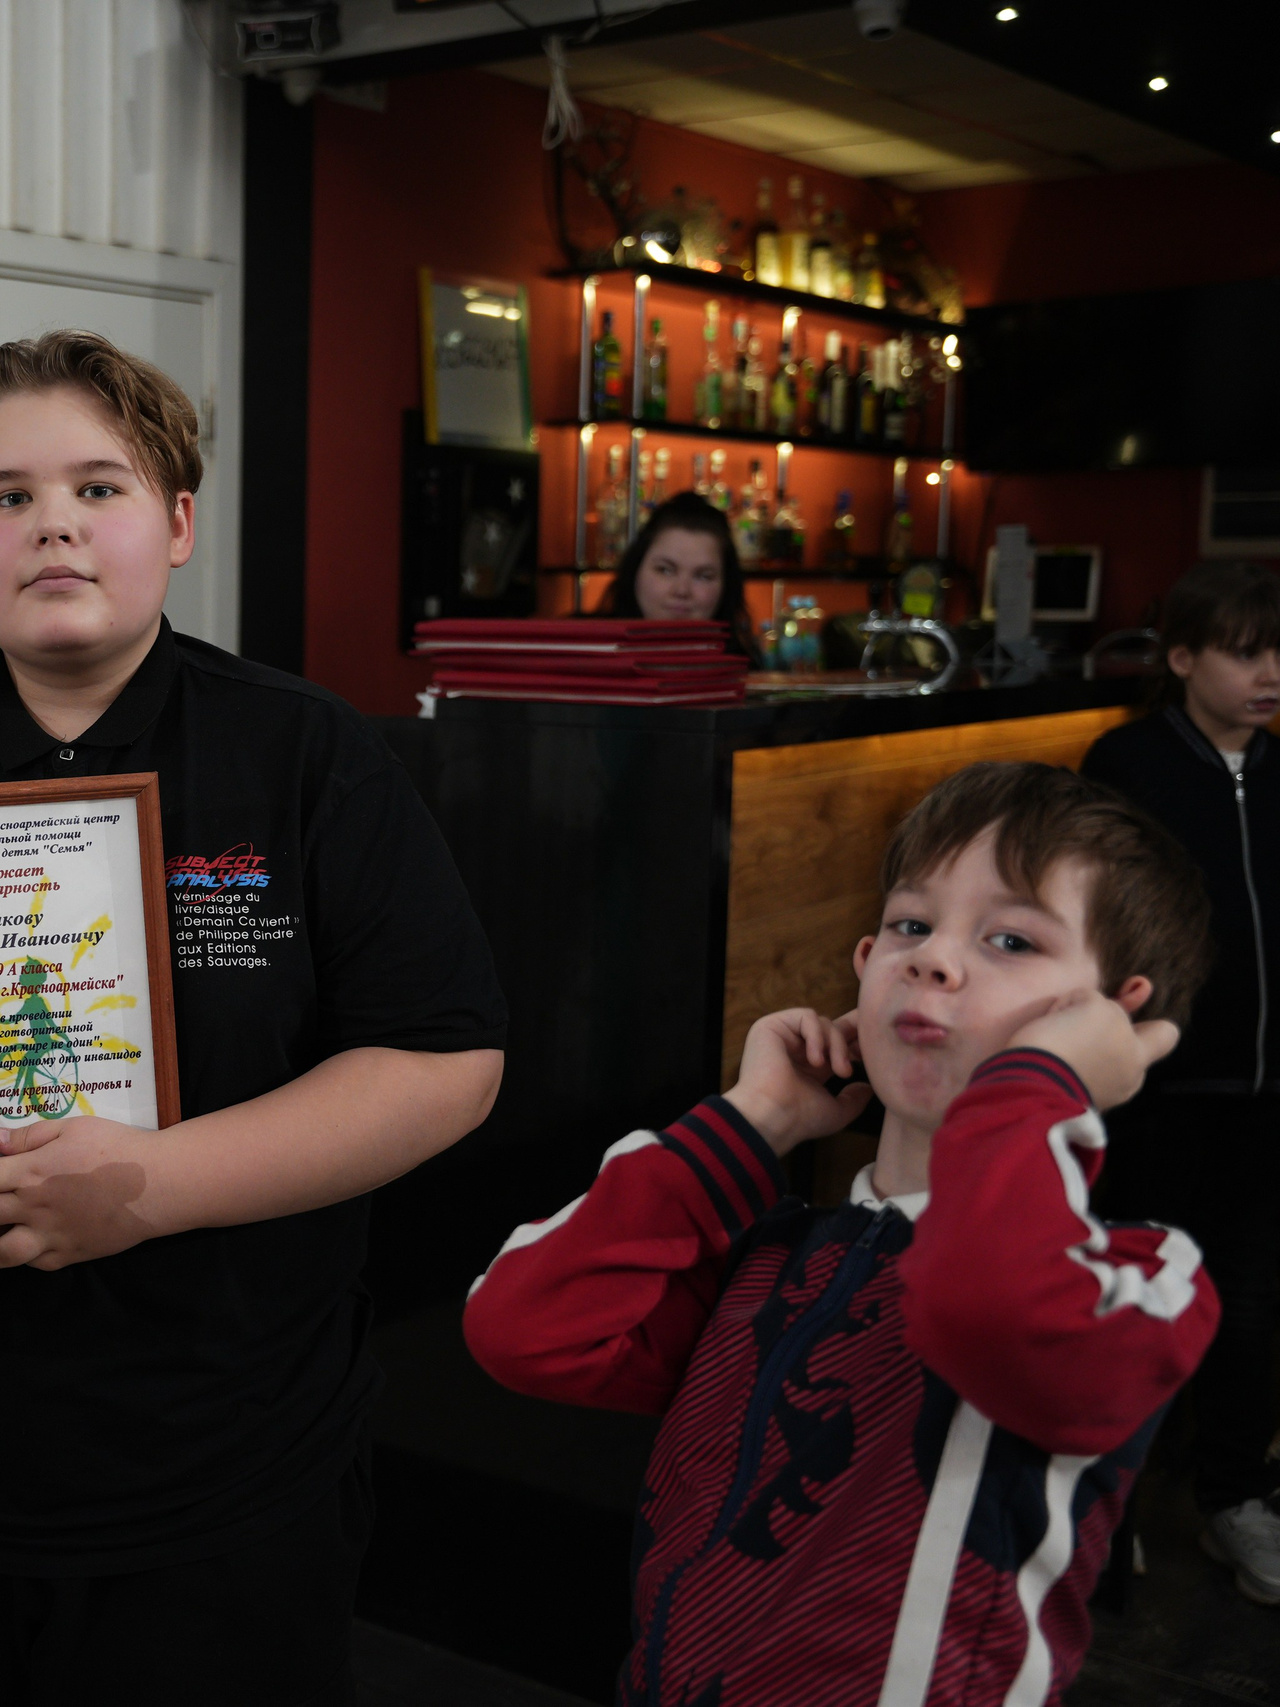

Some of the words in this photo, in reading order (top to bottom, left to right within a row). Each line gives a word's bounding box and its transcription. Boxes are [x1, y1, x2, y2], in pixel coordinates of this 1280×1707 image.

[83, 814, 120, 825] центр
[34, 831, 81, 842] помощи
[2, 847, 39, 859] детям
[167, 874, 271, 888] ANALYSIS
[174, 892, 241, 904] Vernissage
[246, 893, 260, 902] du
[175, 905, 249, 915] livre/disque
[239, 916, 256, 926] Ca
[1, 930, 104, 949] Ивановичу
[176, 931, 193, 940] de
[199, 930, 249, 941] Philippe
[178, 945, 202, 955] aux
[208, 943, 256, 953] Editions
[178, 958, 202, 968] des
[208, 956, 271, 968] Sauvages.
[7, 964, 17, 975] А
[21, 962, 63, 974] класса
[0, 1015, 5, 1023] в
[9, 1010, 72, 1024] проведении
[20, 1042, 47, 1053] мире
[51, 1040, 64, 1048] не
[58, 1053, 81, 1064] дню
[84, 1049, 141, 1061] инвалидов
[23, 1083, 71, 1097] крепкого
[74, 1079, 121, 1093] здоровья
[125, 1079, 131, 1088] и
[17, 1106, 22, 1114] в
[25, 1100, 59, 1116] учебе!
